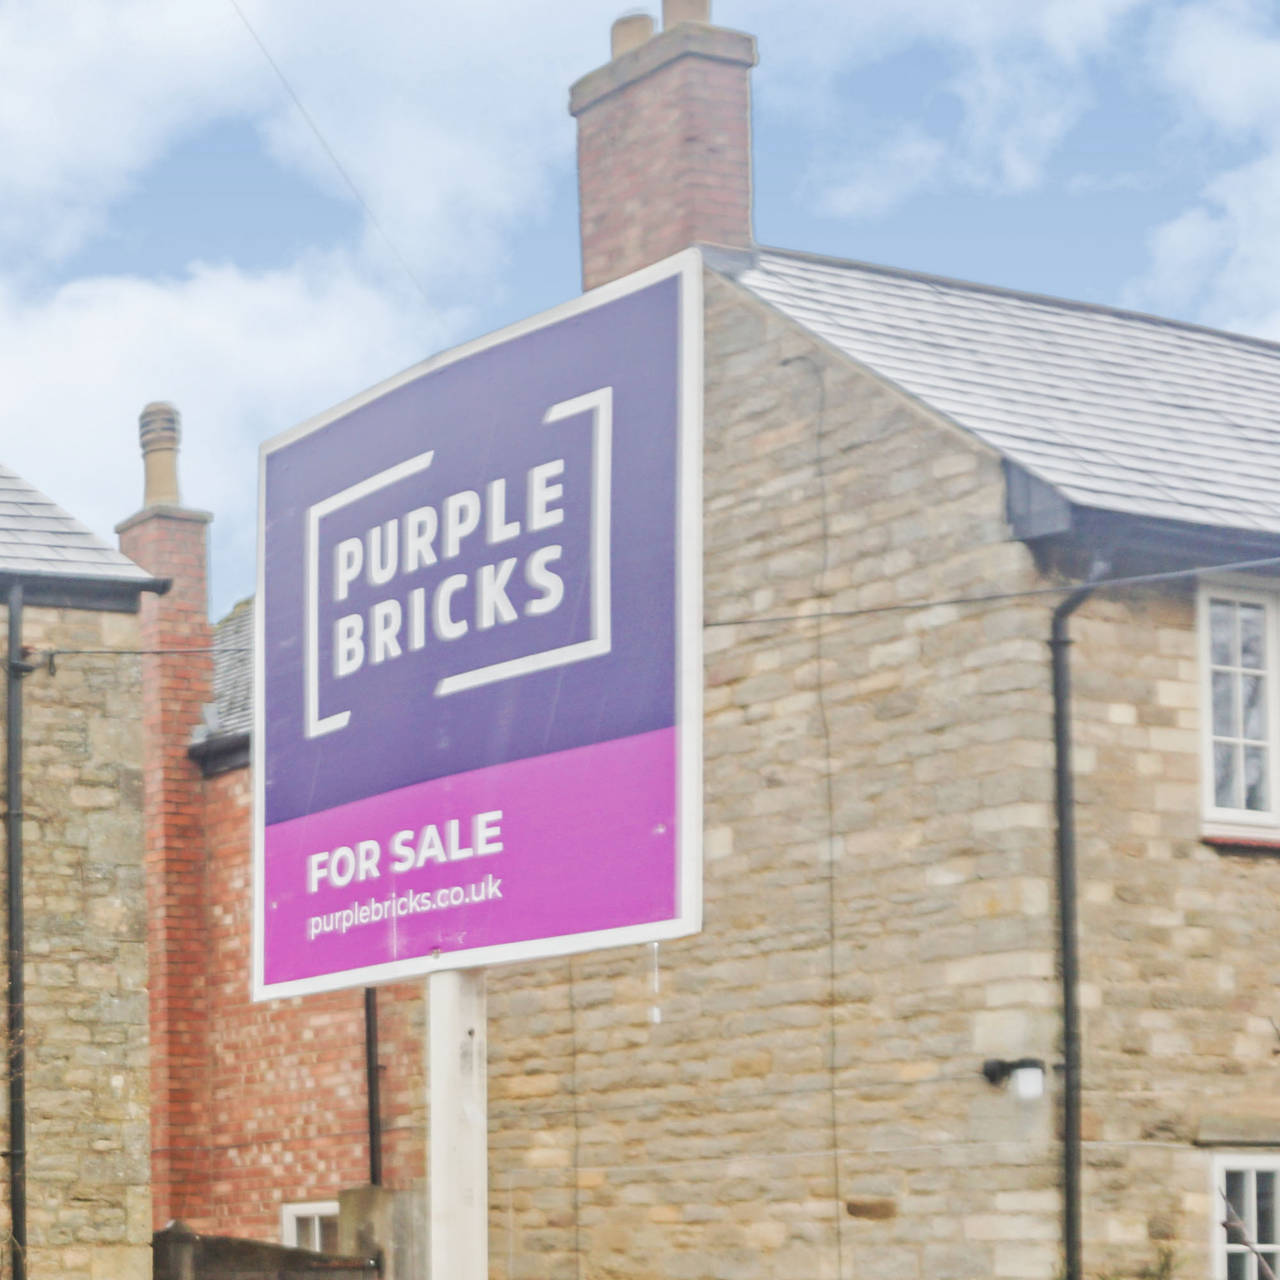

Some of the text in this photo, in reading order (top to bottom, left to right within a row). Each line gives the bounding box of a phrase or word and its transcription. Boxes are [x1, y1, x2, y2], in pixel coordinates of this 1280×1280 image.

[336, 458, 565, 601] PURPLE
[335, 545, 565, 679] BRICKS
[308, 810, 504, 893] FOR SALE
[309, 874, 504, 940] purplebricks.co.uk
